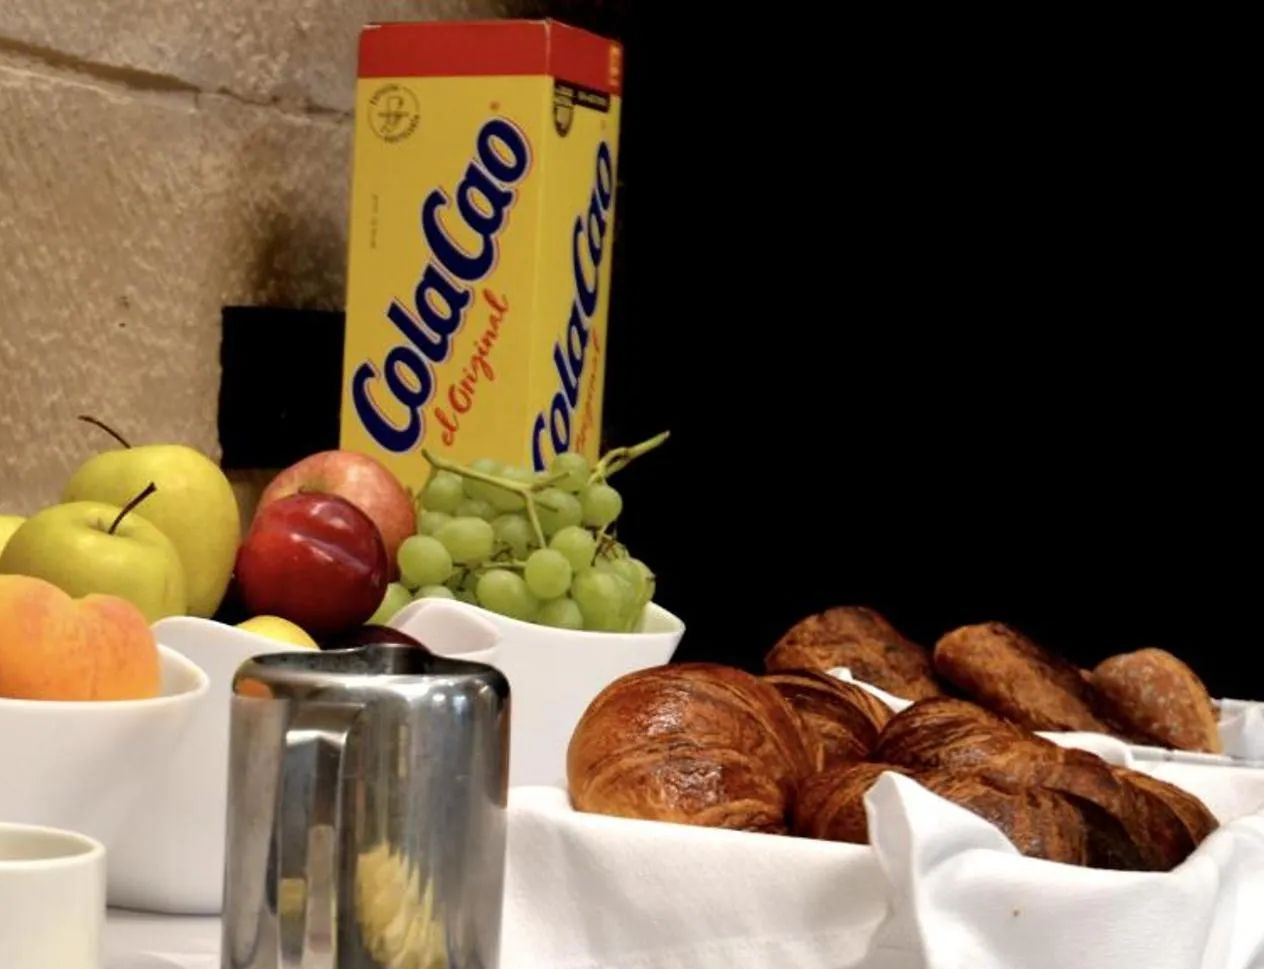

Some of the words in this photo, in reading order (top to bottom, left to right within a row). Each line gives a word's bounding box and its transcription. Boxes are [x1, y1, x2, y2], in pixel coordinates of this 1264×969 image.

[352, 117, 530, 453] ColaCao
[435, 406, 459, 446] el
[448, 288, 508, 414] Original
